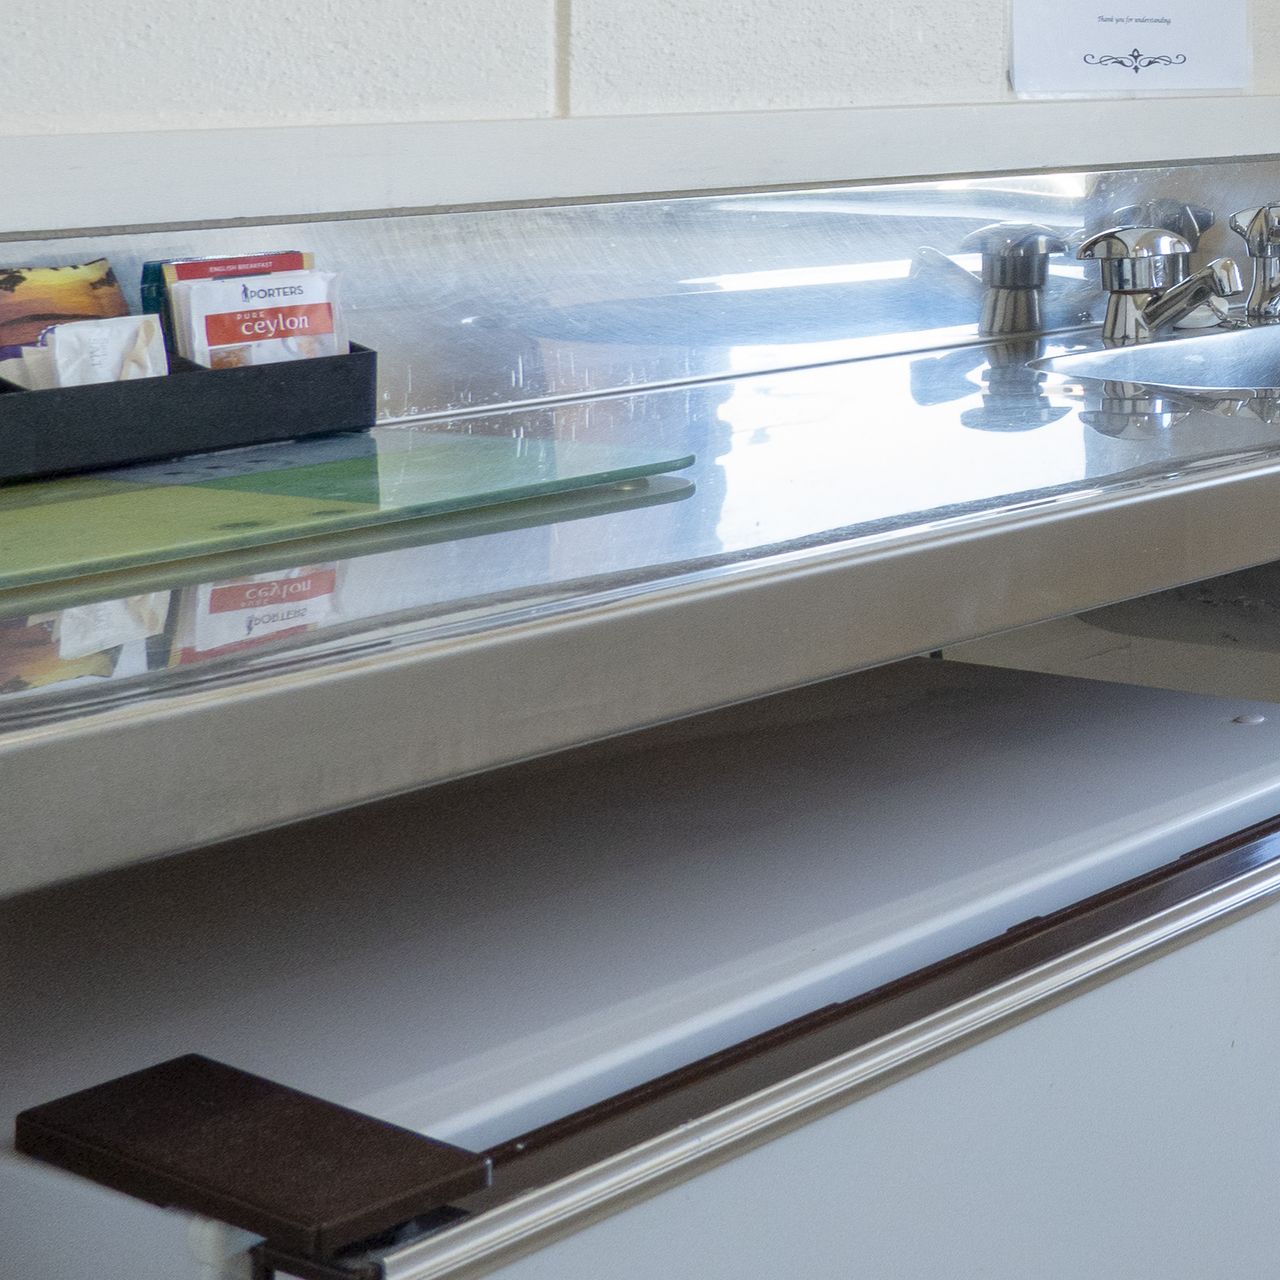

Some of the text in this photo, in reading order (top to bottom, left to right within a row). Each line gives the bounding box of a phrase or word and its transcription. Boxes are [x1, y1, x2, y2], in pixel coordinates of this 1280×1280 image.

[1125, 16, 1133, 24] for
[209, 261, 273, 273] ENGLISH BREAKFAST
[250, 285, 304, 300] PORTERS
[236, 310, 265, 321] PURE
[241, 313, 309, 337] ceylon
